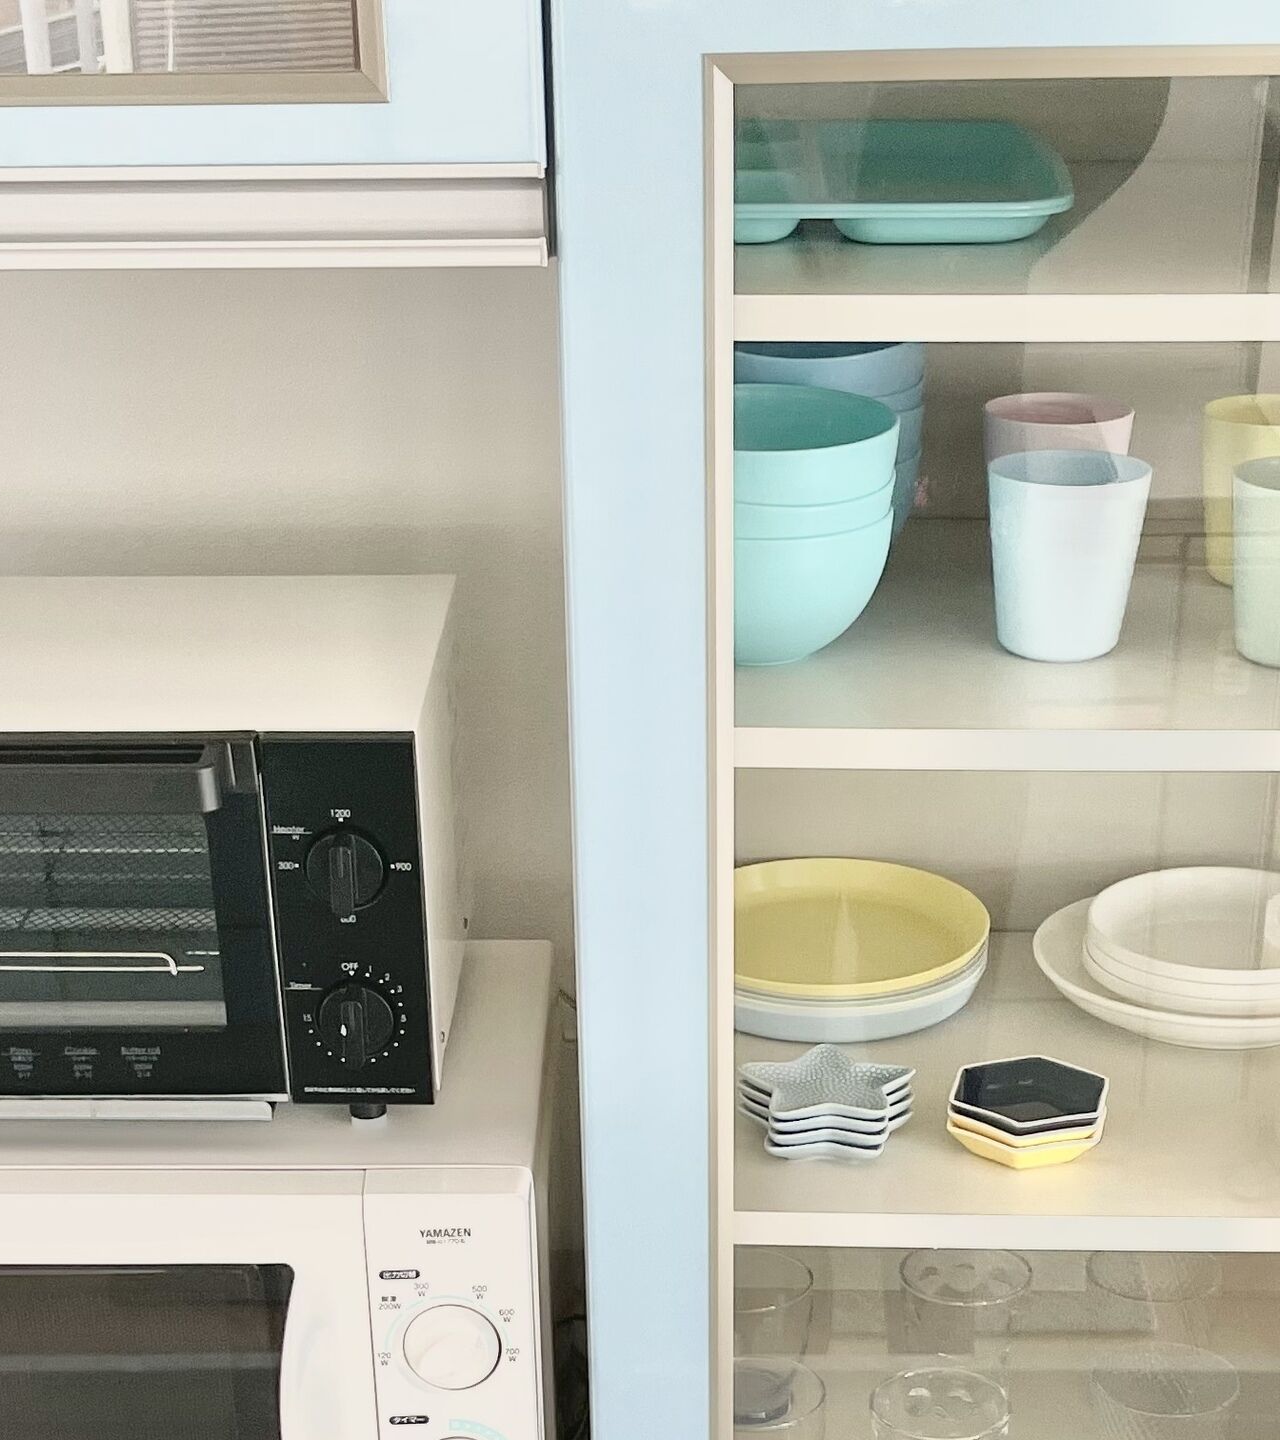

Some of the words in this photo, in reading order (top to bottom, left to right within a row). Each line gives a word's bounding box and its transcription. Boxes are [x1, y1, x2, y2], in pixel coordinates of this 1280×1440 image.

[331, 809, 351, 818] 1200
[396, 863, 412, 871] 900
[341, 962, 359, 971] OFF
[384, 973, 391, 981] 2
[419, 1228, 471, 1238] YAMAZEN
[472, 1285, 487, 1293] 500
